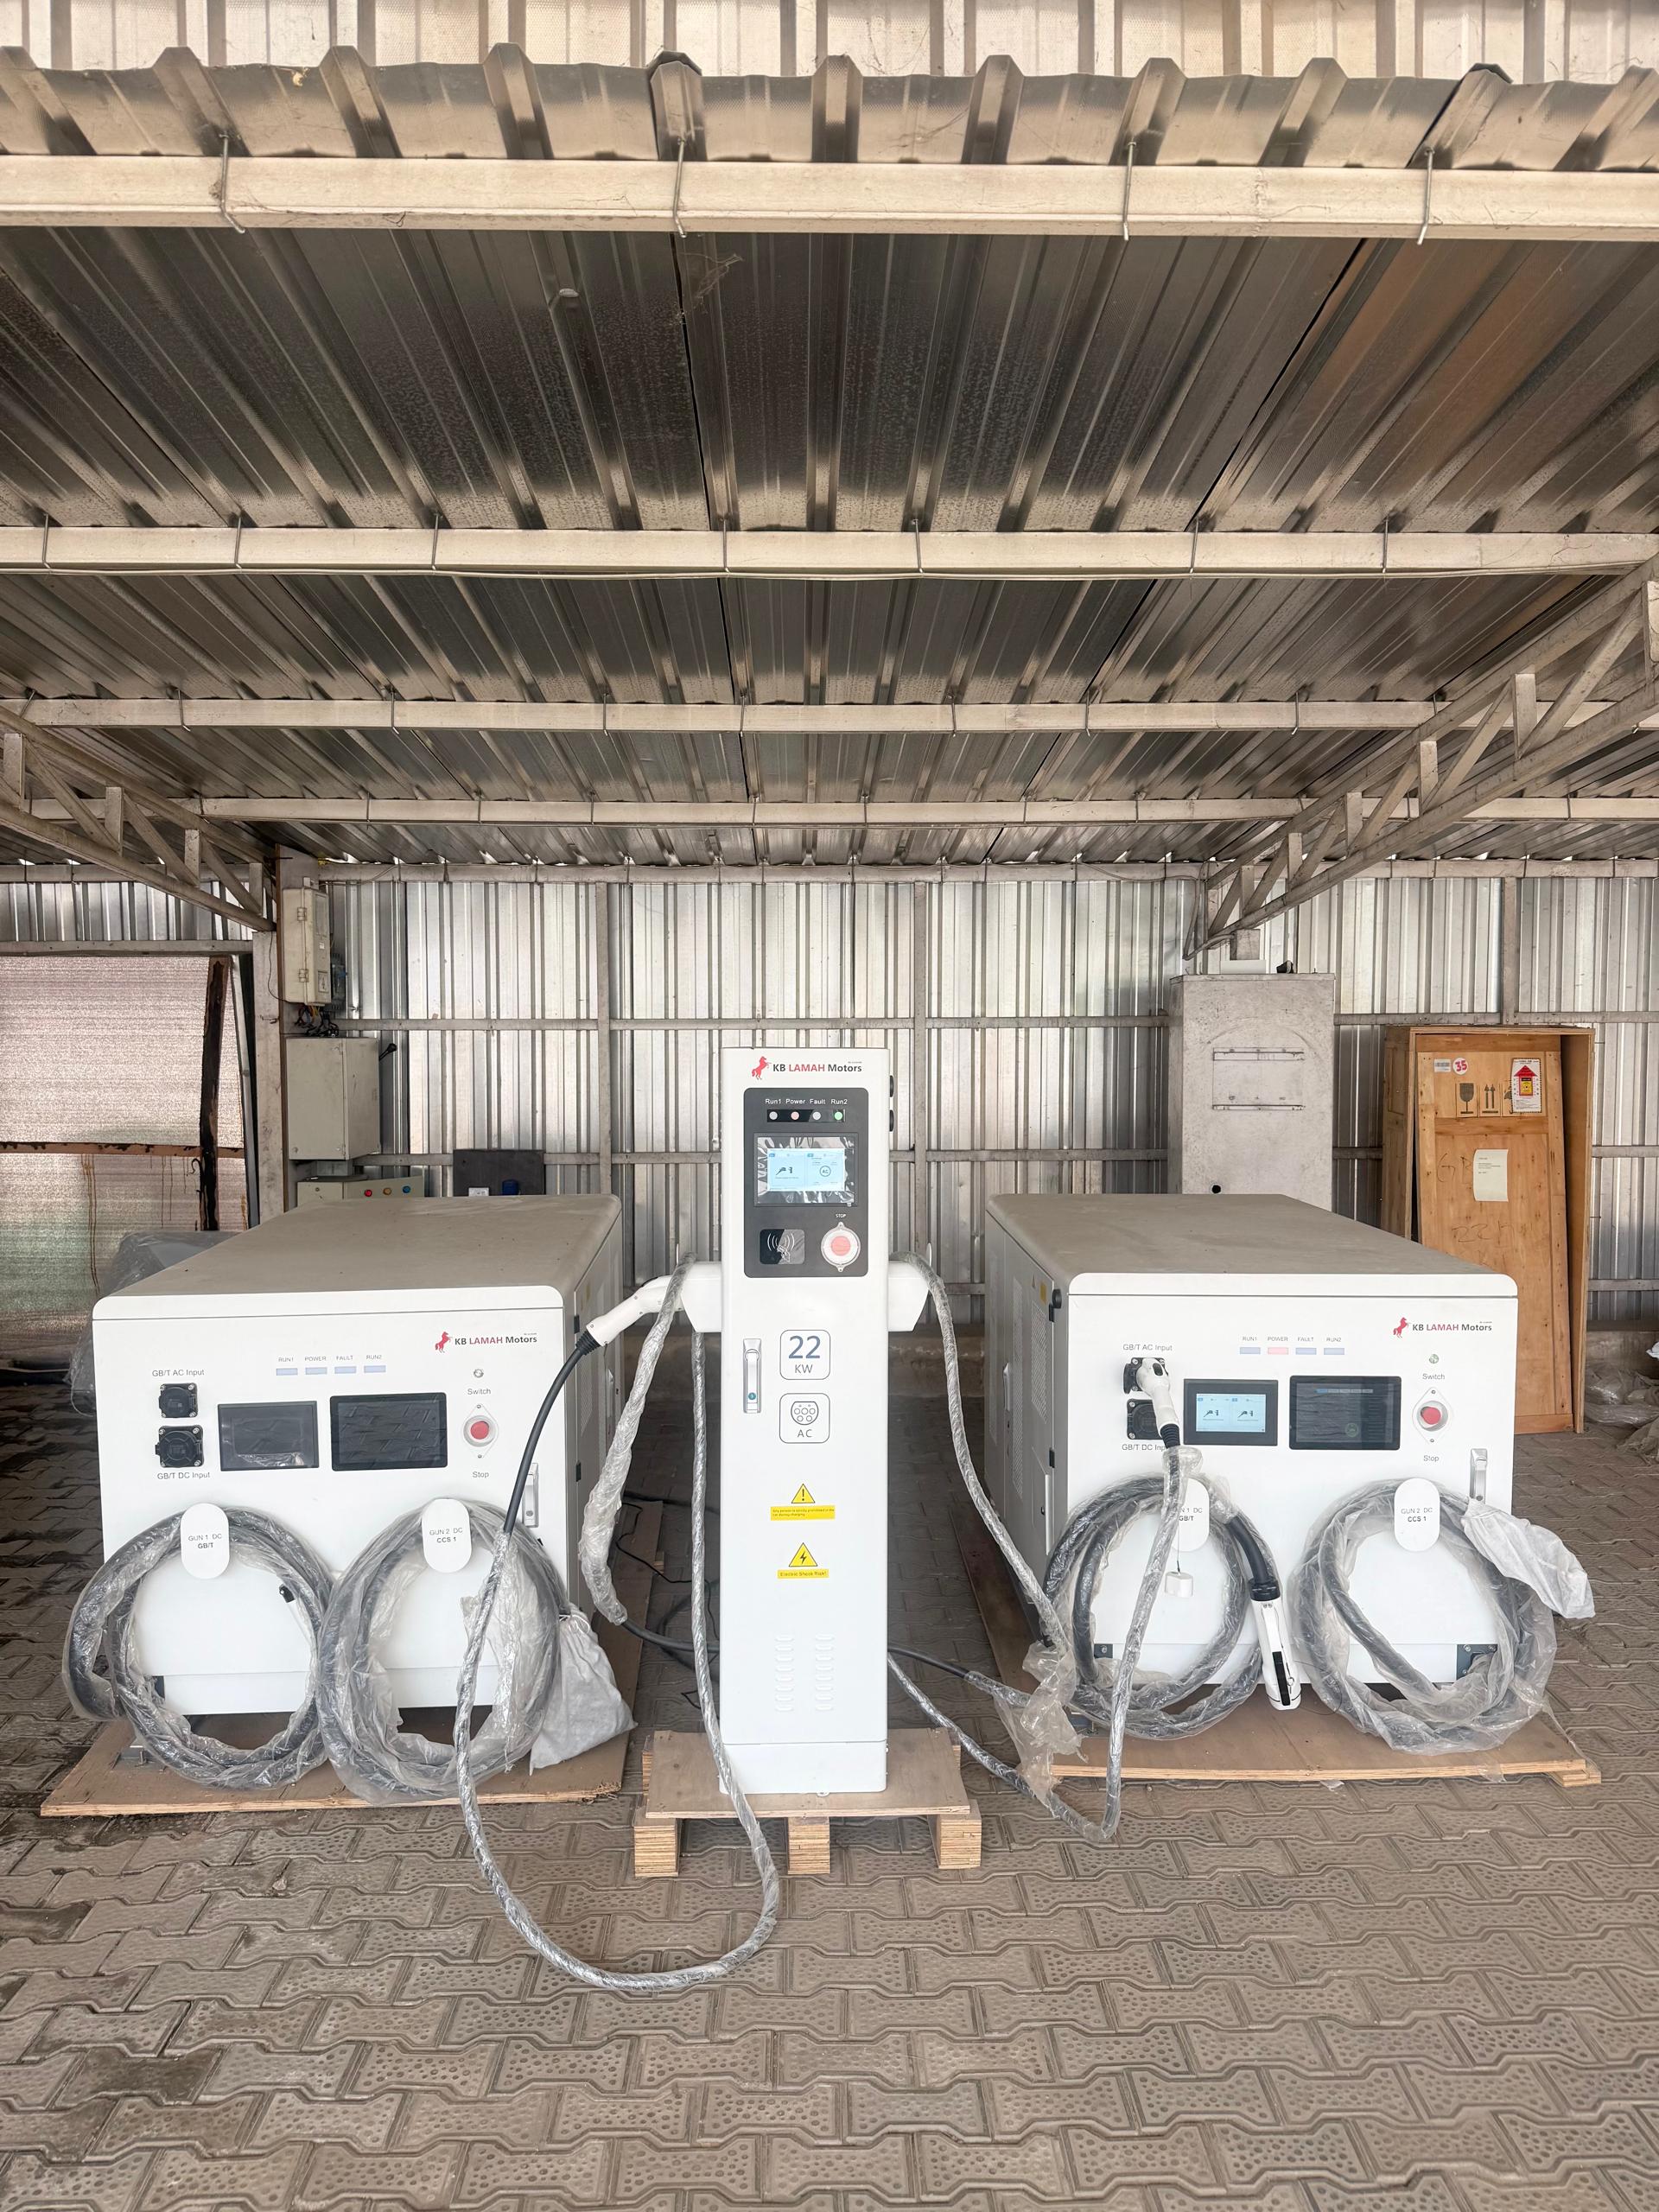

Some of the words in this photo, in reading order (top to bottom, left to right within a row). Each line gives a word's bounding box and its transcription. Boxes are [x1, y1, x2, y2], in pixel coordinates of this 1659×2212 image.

[828, 1064, 862, 1072] Motors
[1455, 1060, 1467, 1071] 35
[788, 1335, 821, 1359] 22
[1155, 1344, 1173, 1352] Input
[186, 1368, 205, 1377] Input
[794, 1364, 813, 1374] KW
